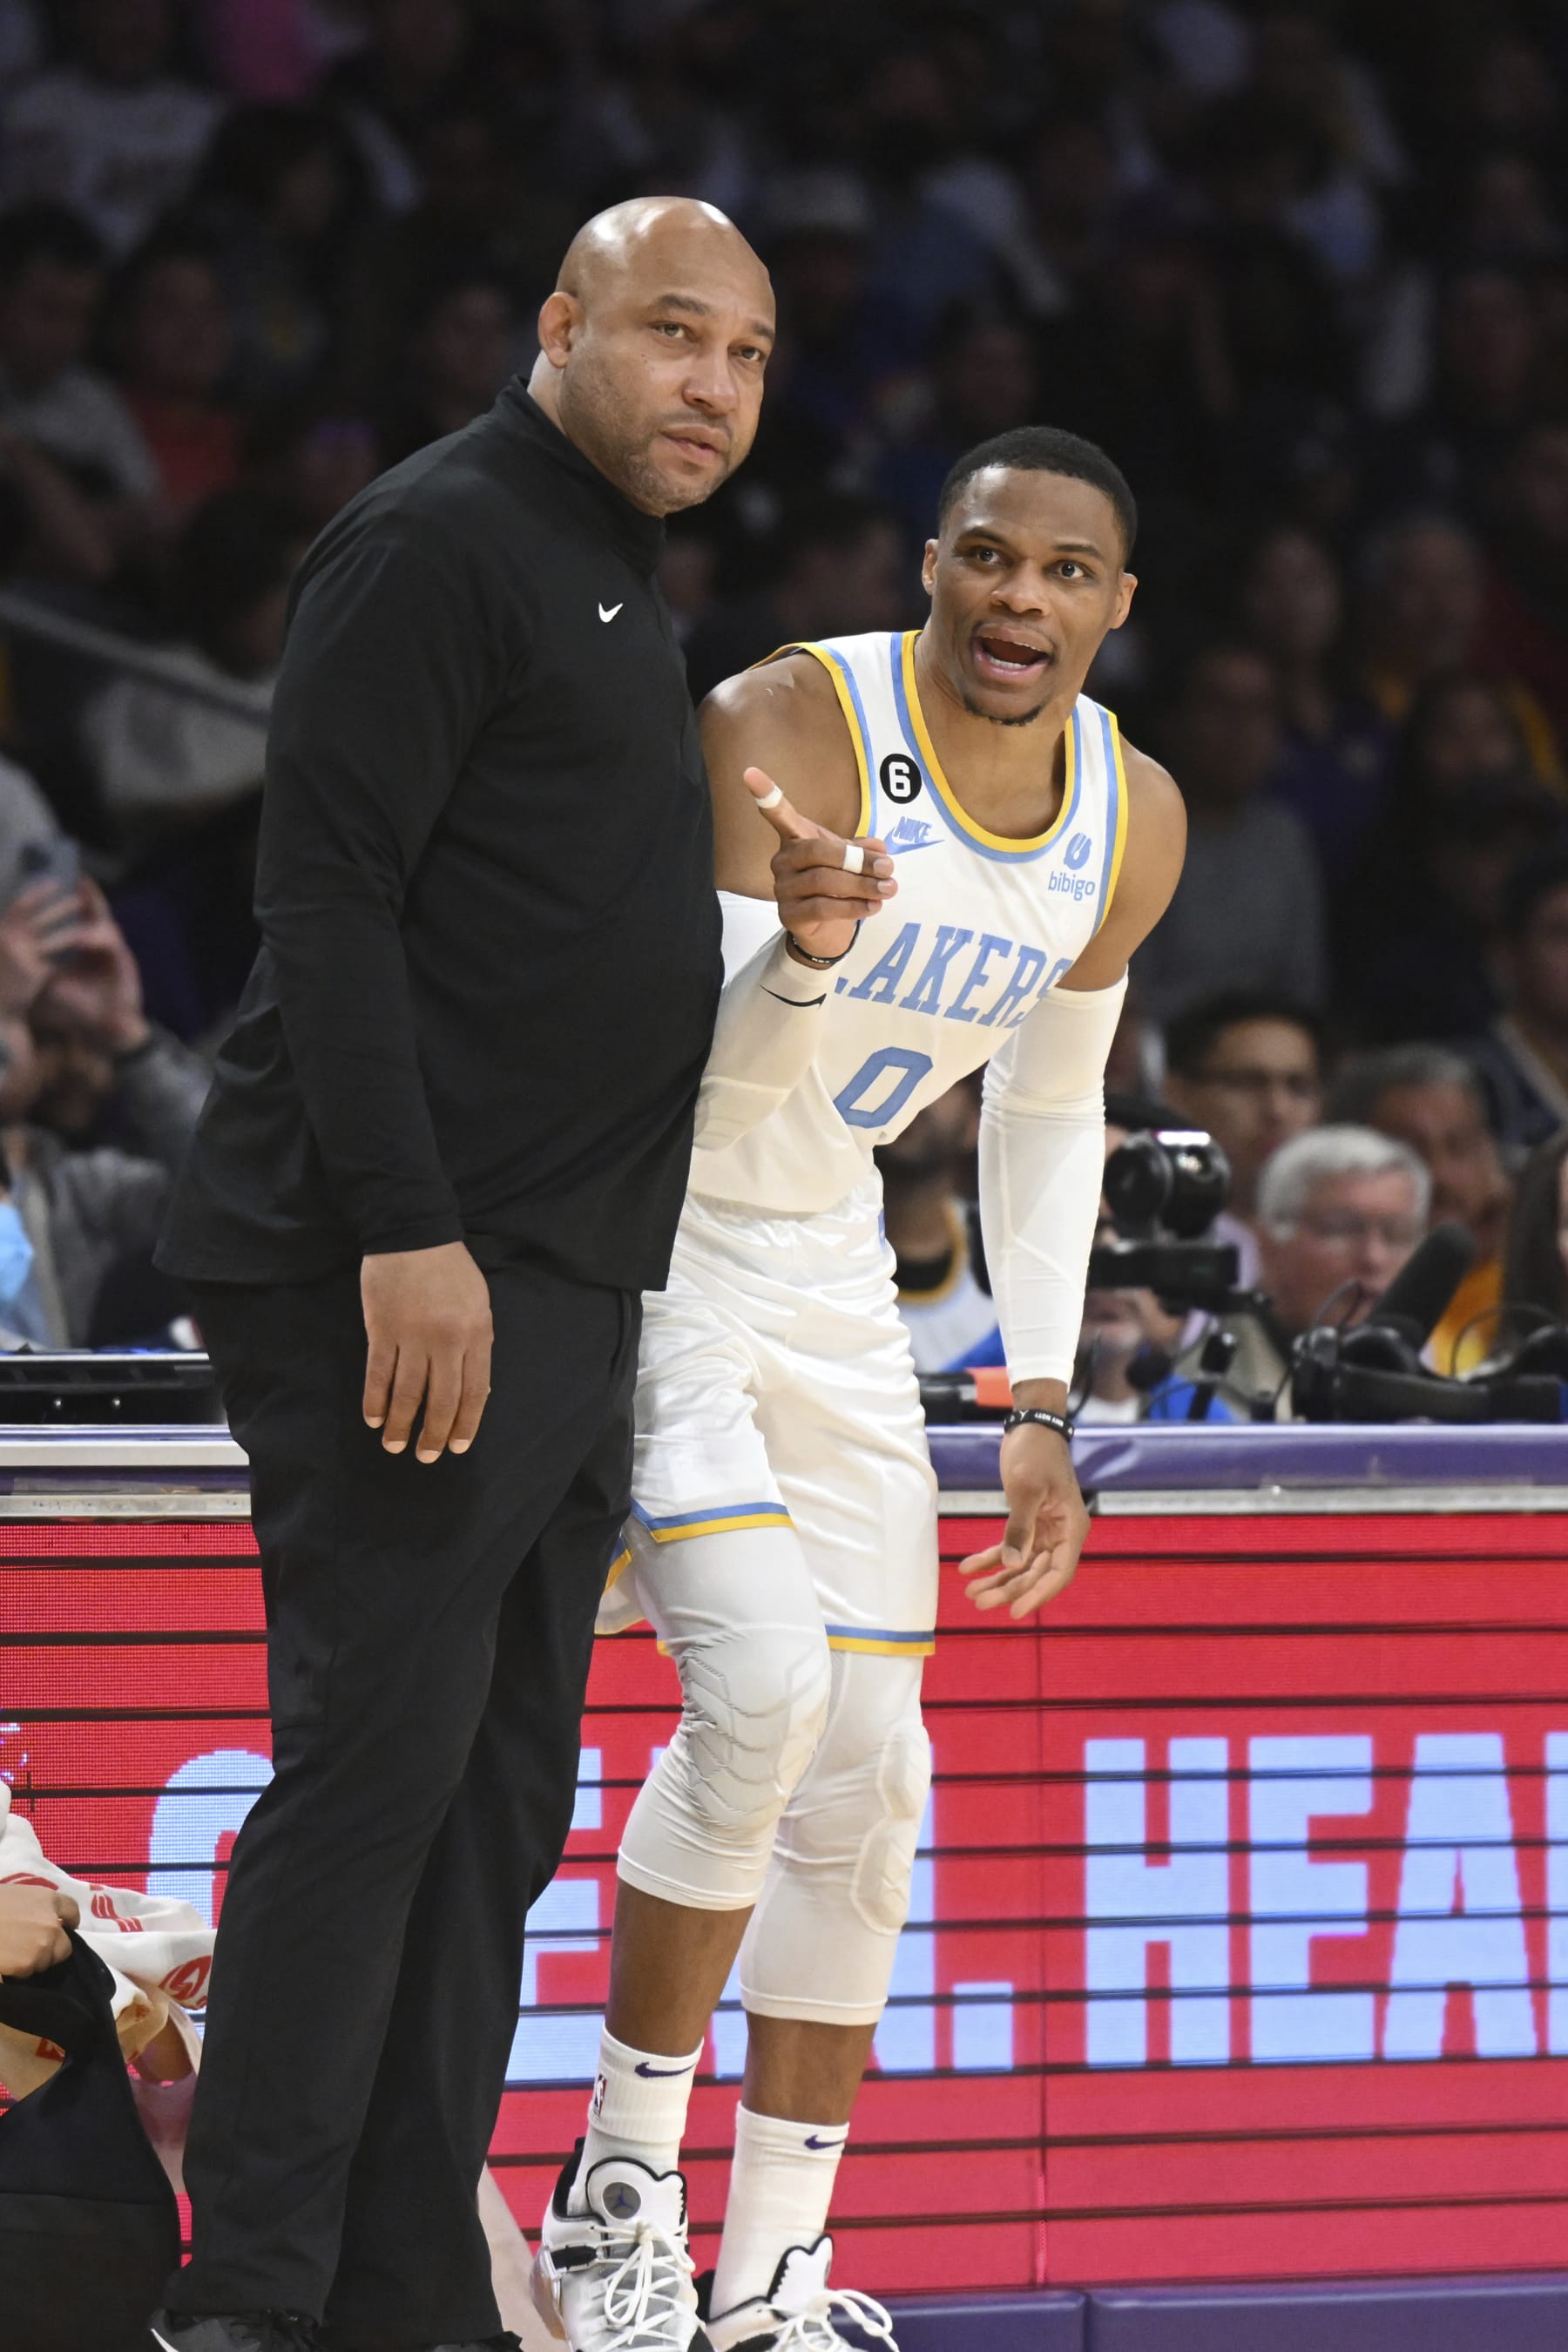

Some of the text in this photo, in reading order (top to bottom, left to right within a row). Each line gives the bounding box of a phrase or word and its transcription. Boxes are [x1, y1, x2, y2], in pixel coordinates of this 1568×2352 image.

[889, 761, 911, 798] 6
[892, 815, 933, 845] NIKE
[1048, 871, 1096, 902] bibigo
[834, 923, 1074, 1029] AKER
[833, 1046, 934, 1129] 0
